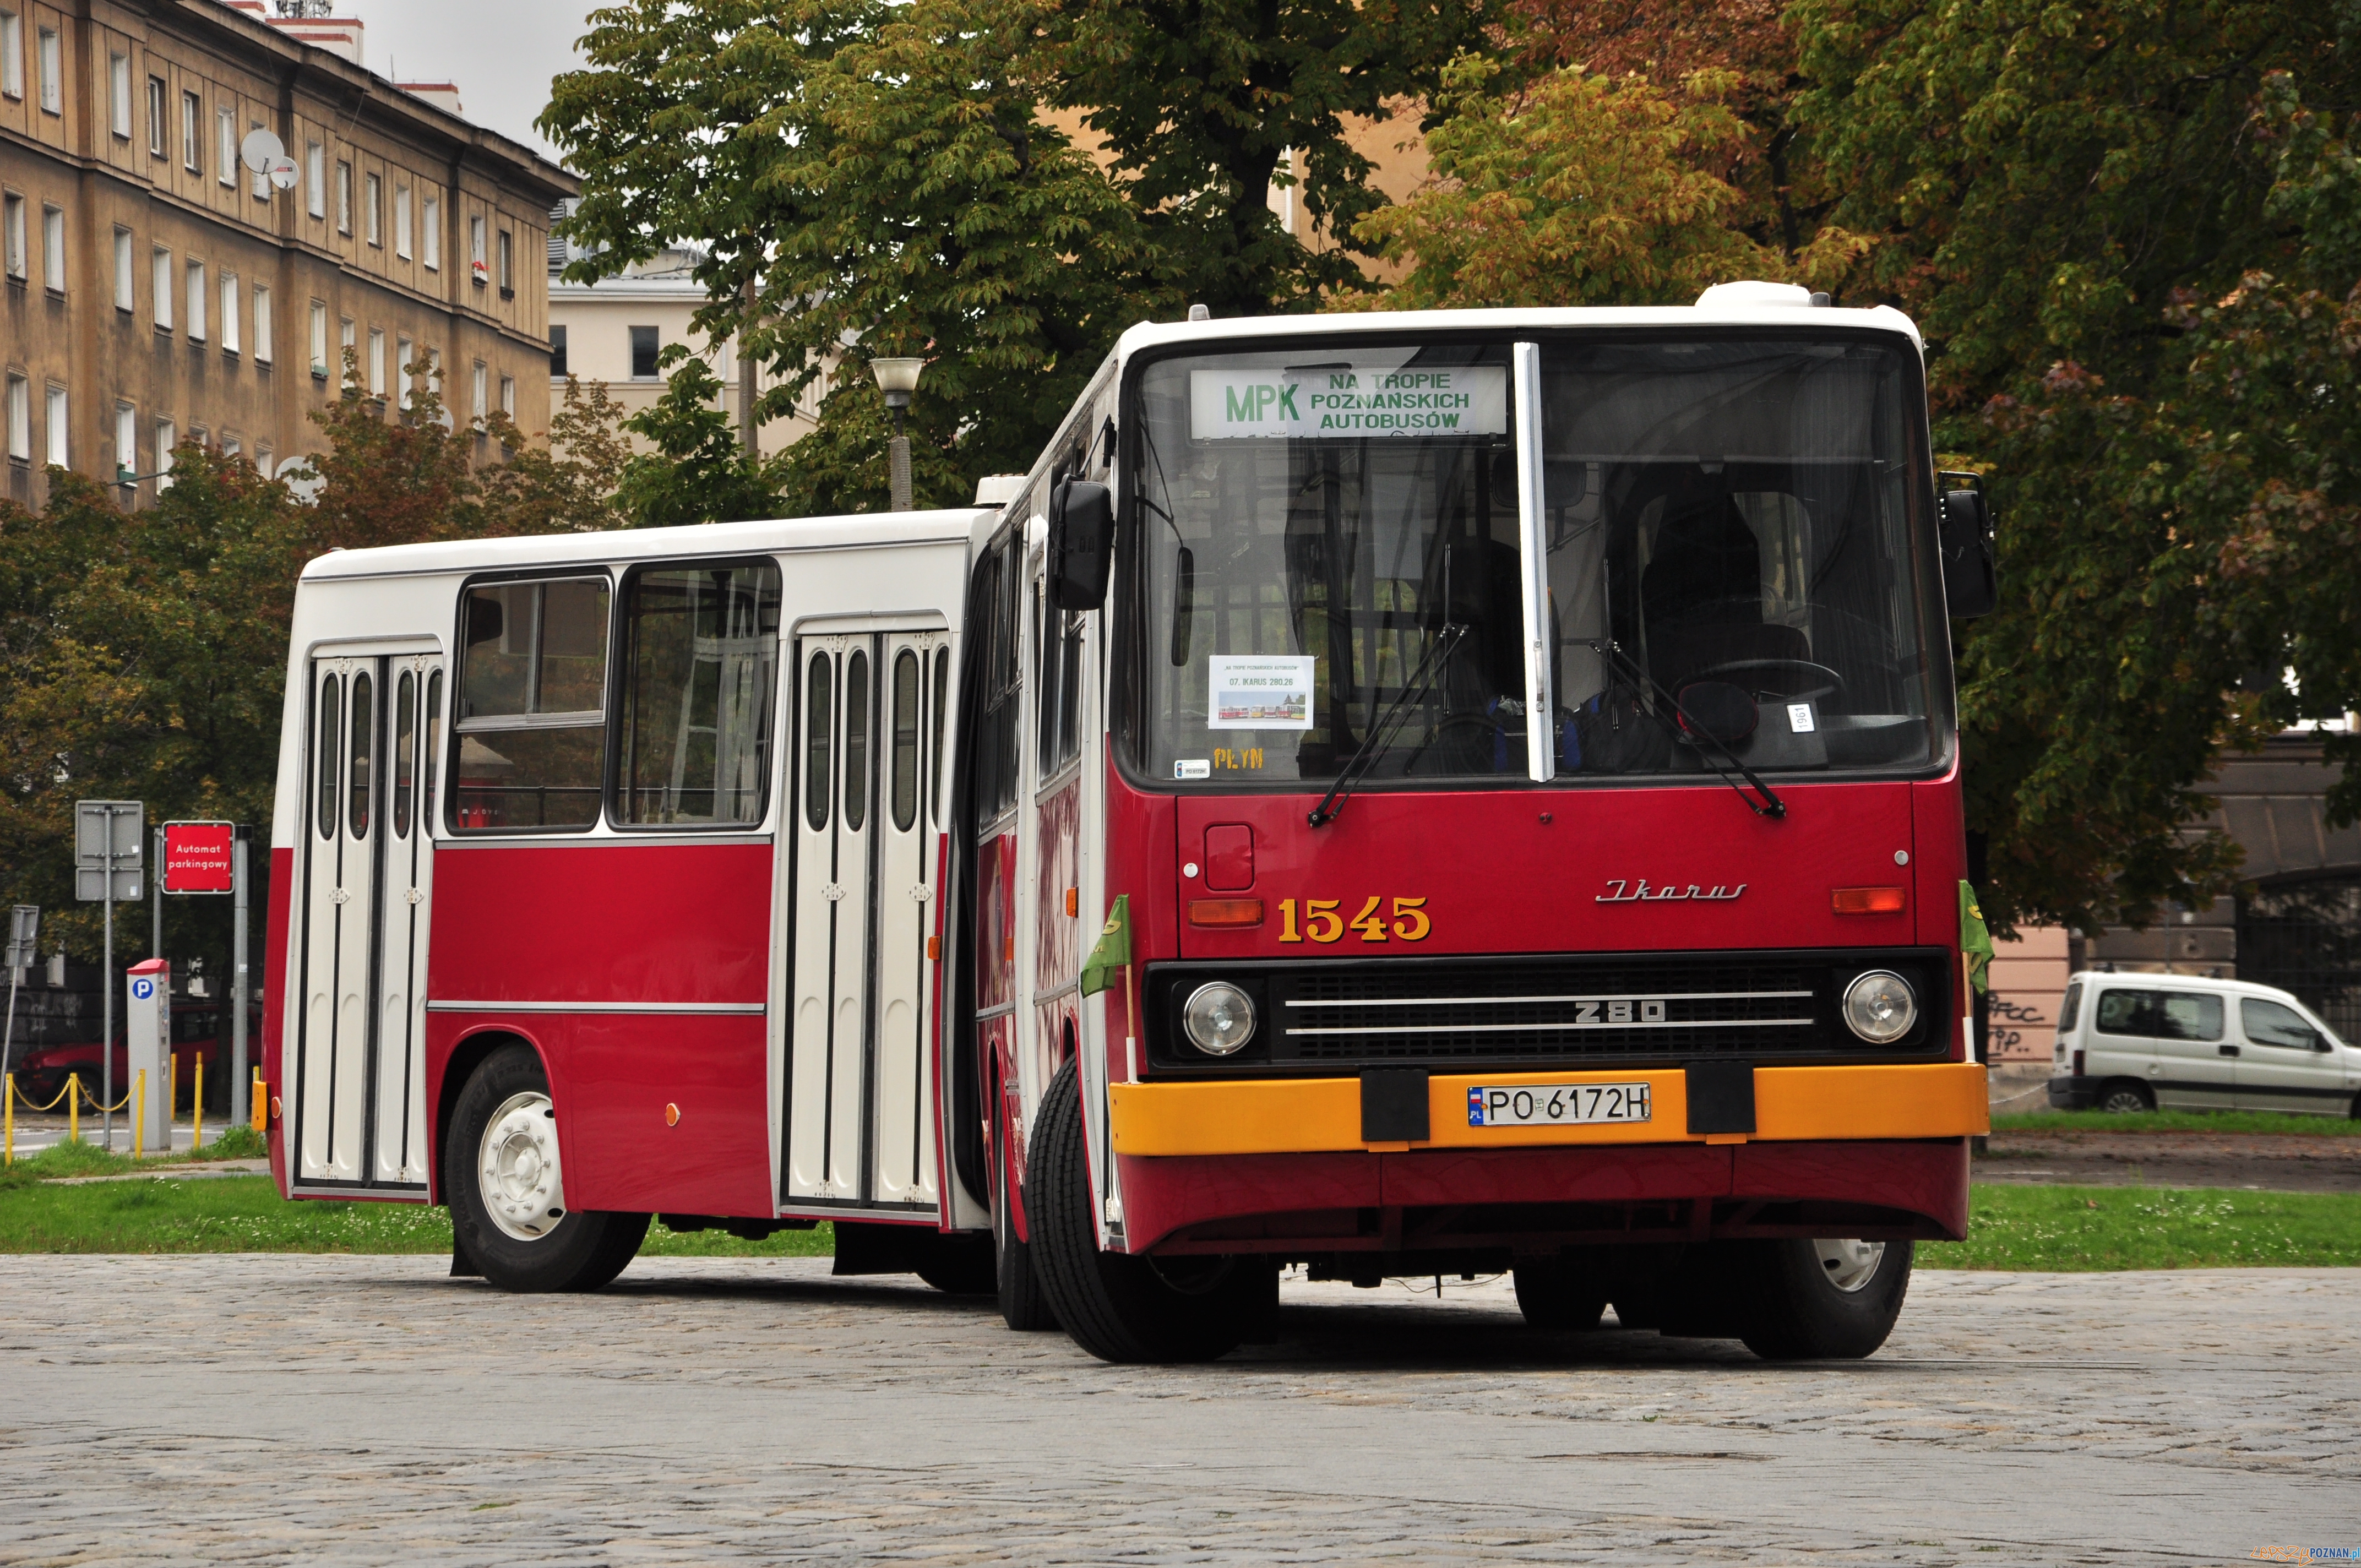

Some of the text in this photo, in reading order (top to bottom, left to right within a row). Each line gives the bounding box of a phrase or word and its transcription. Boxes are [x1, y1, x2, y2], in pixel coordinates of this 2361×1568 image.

[1329, 373, 1450, 390] NA TROPIE
[1226, 384, 1300, 422] MPK
[1310, 391, 1470, 409] POZNAŃSKICH
[1320, 411, 1460, 429] AUTOBUSÓW
[1794, 707, 1808, 728] 1961
[1214, 747, 1264, 770] PŁYN
[176, 844, 221, 853] Automat
[168, 859, 227, 871] parkingowy
[1595, 879, 1747, 902] Ikarus
[1279, 896, 1433, 943] 1545
[138, 981, 149, 997] P
[1489, 1087, 1645, 1121] PO 6172H
[1471, 1110, 1482, 1119] PL
